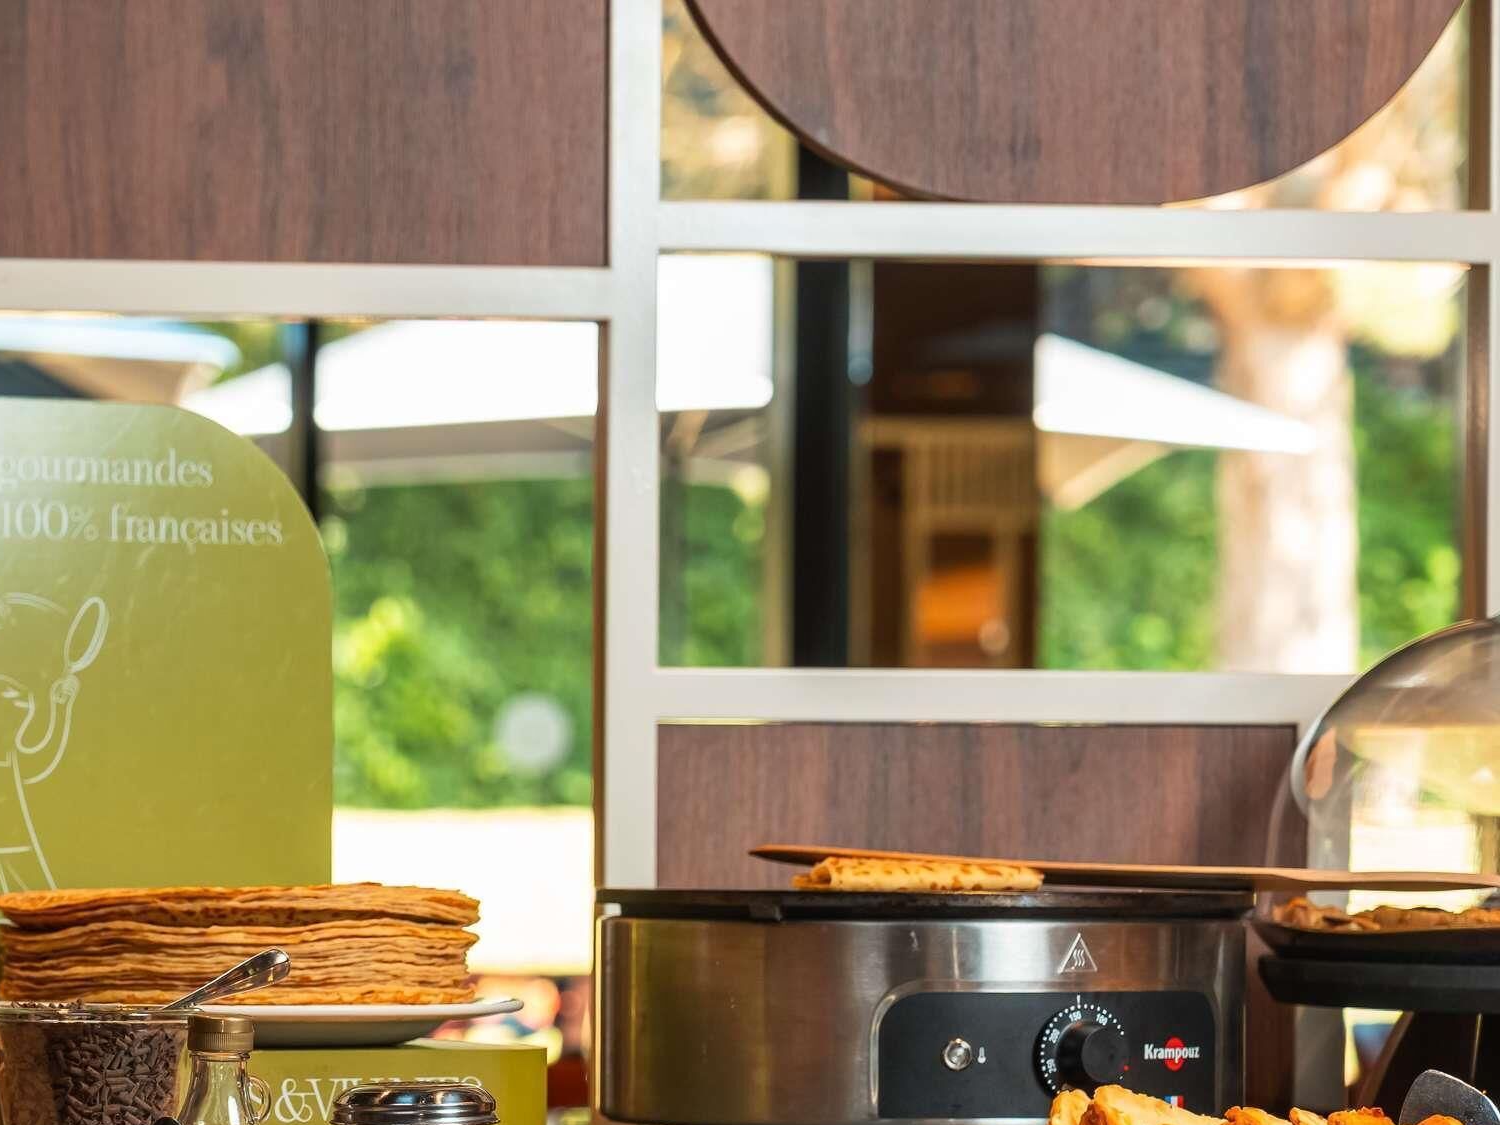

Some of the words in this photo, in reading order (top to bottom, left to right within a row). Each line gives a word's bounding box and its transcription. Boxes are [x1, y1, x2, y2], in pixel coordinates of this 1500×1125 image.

[2, 501, 101, 543] 100%
[109, 502, 286, 554] françaises
[1143, 1043, 1201, 1064] Krampouz
